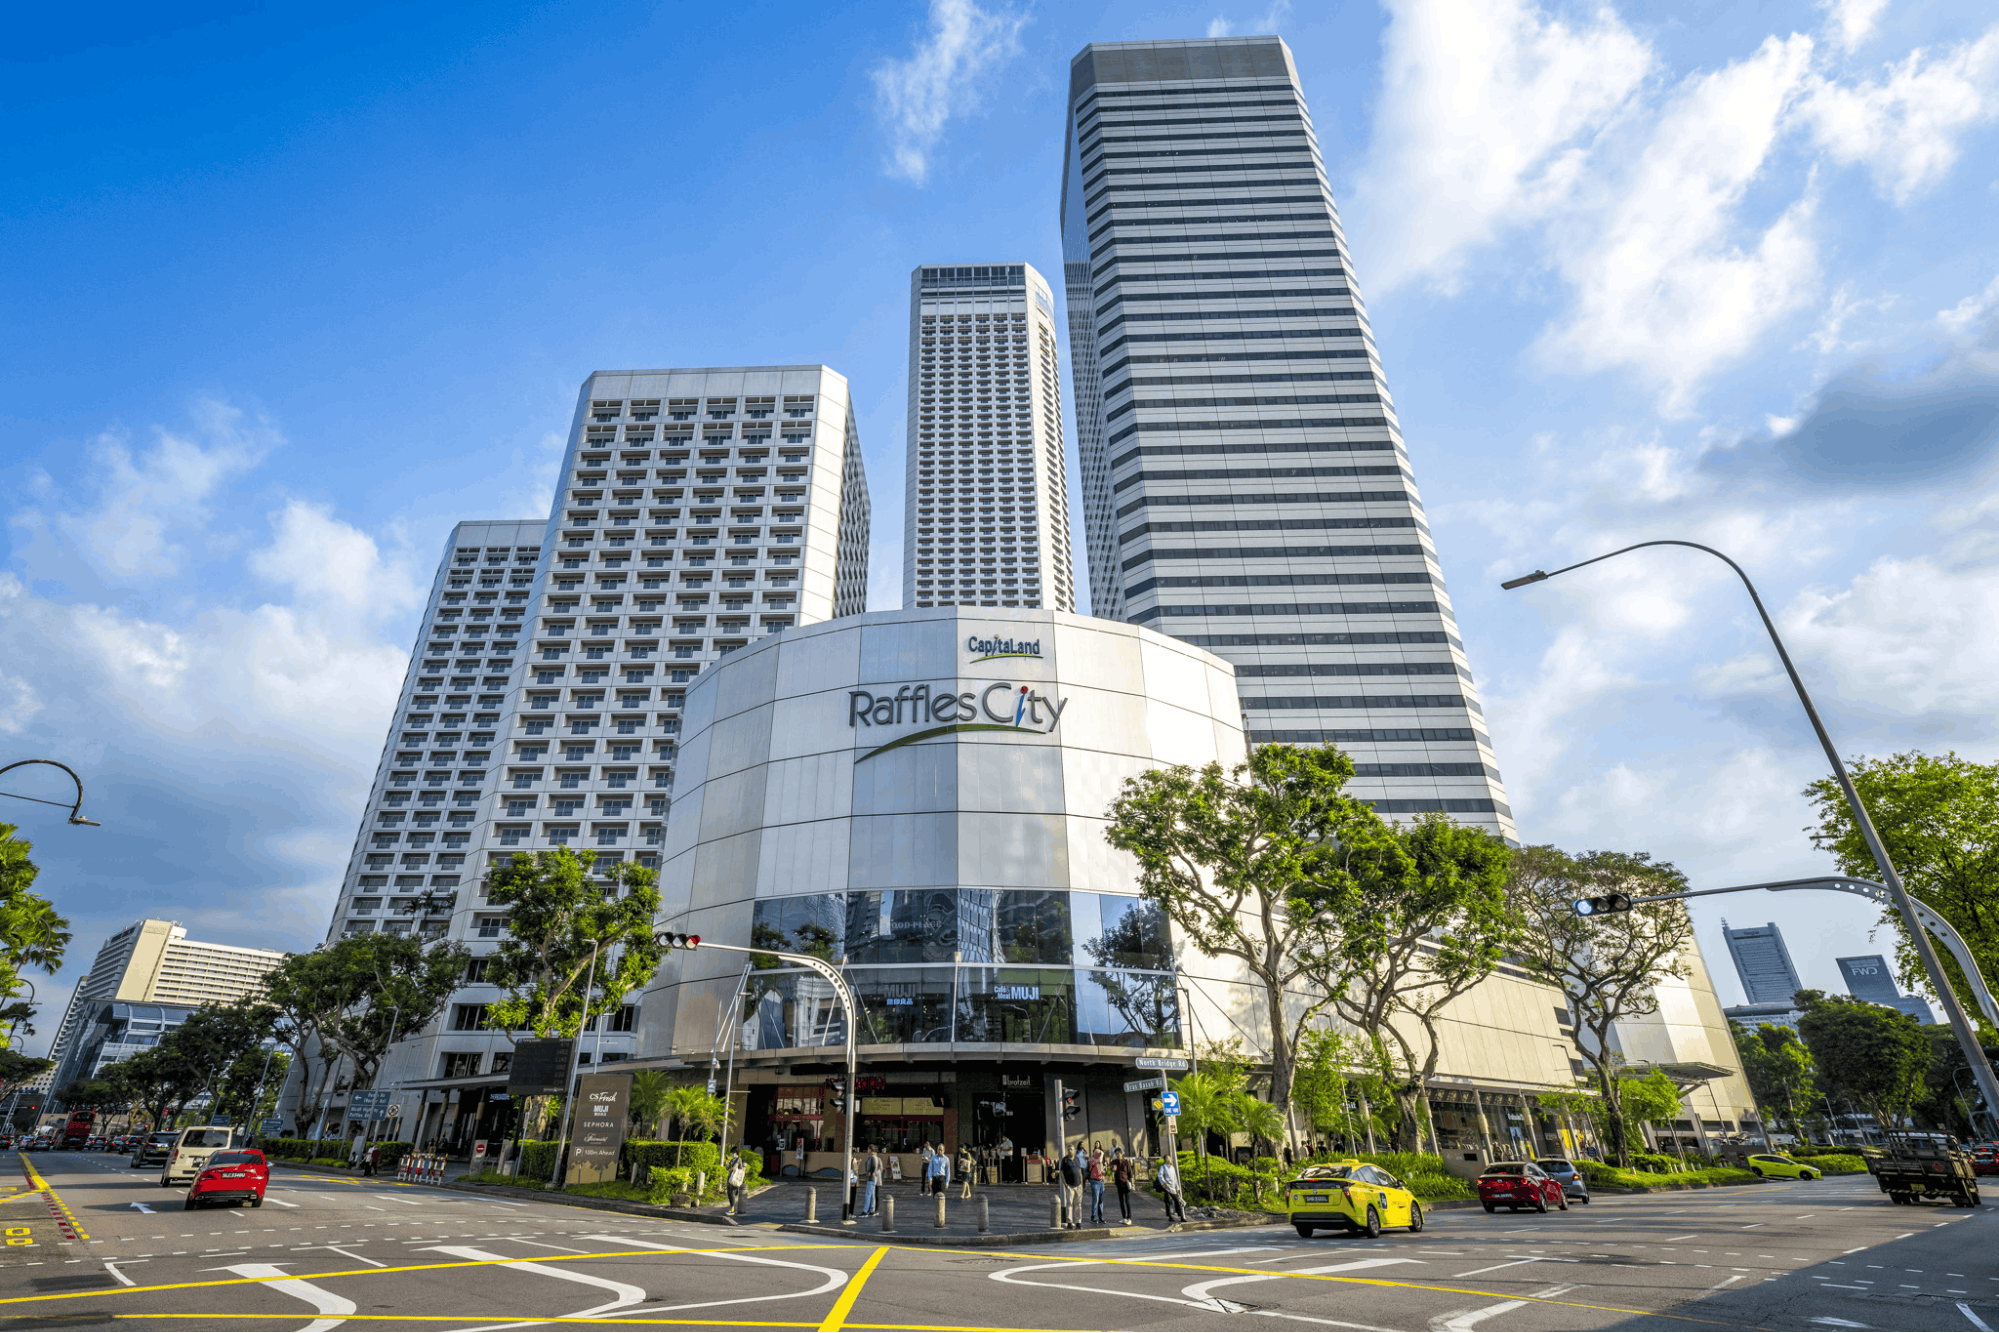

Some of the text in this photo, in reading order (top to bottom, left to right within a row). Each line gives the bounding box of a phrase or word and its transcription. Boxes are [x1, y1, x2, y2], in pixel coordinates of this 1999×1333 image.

[968, 634, 1041, 656] CapitaLand
[848, 682, 1068, 732] Raffles City
[1852, 967, 1878, 976] FWD
[884, 984, 916, 998] MUJI
[1011, 986, 1039, 1000] MUJI
[1138, 1059, 1156, 1067] North
[1157, 1059, 1176, 1069] Bridge
[599, 1091, 618, 1102] Fresh
[593, 1105, 609, 1113] MUJI
